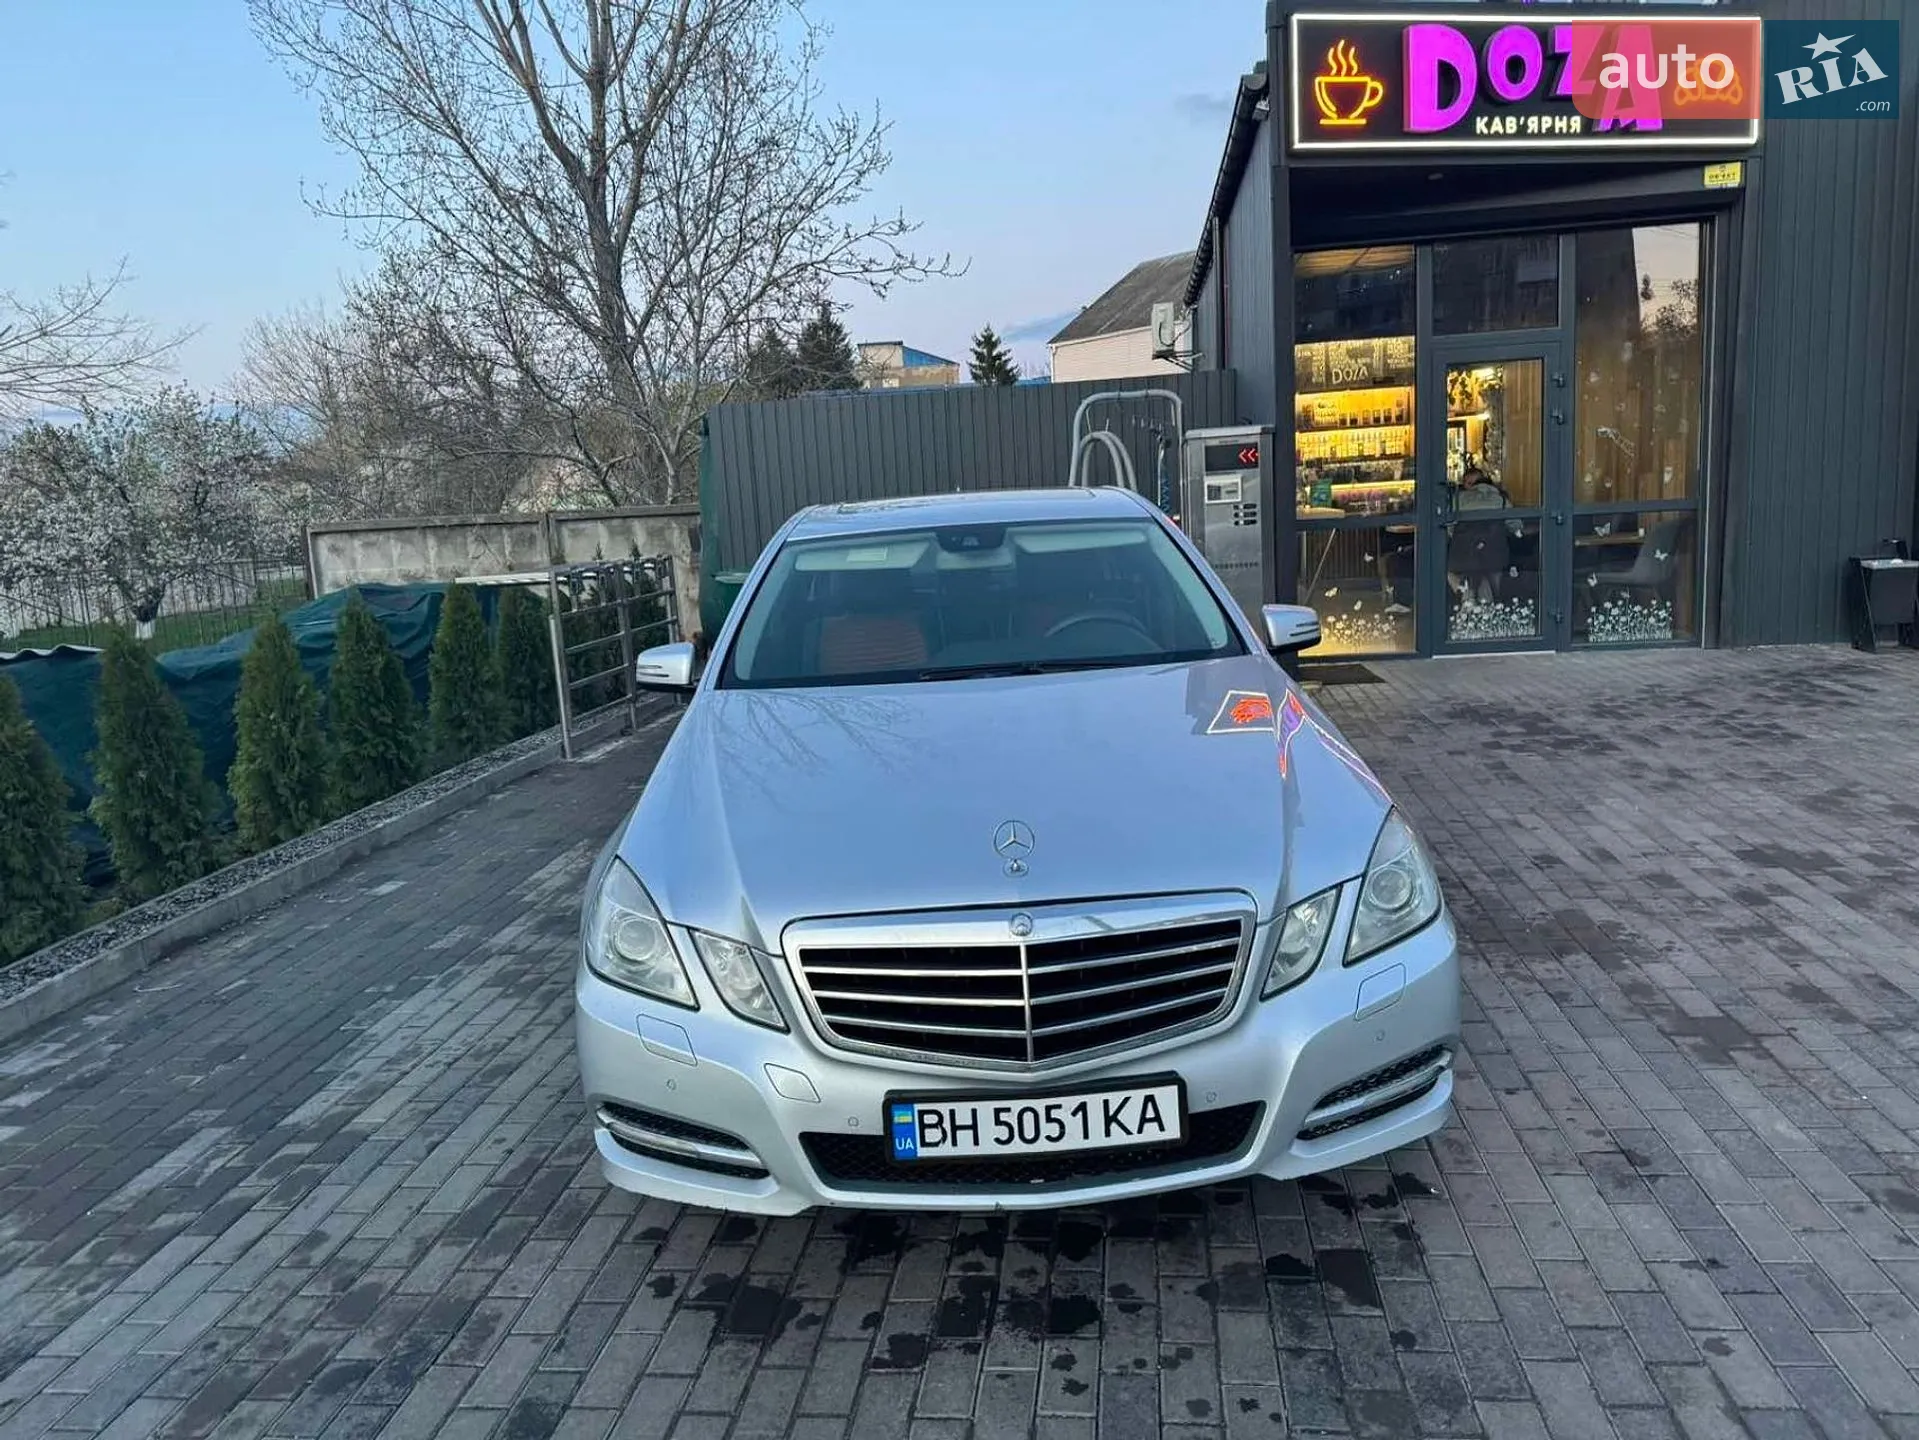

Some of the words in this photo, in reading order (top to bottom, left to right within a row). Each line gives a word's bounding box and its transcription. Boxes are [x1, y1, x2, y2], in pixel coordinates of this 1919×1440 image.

[1475, 116, 1582, 135] КАВ'ЯРНЯ
[917, 1108, 979, 1148] BH
[993, 1101, 1089, 1145] 5051
[1102, 1093, 1165, 1138] KA
[896, 1135, 915, 1151] UA
